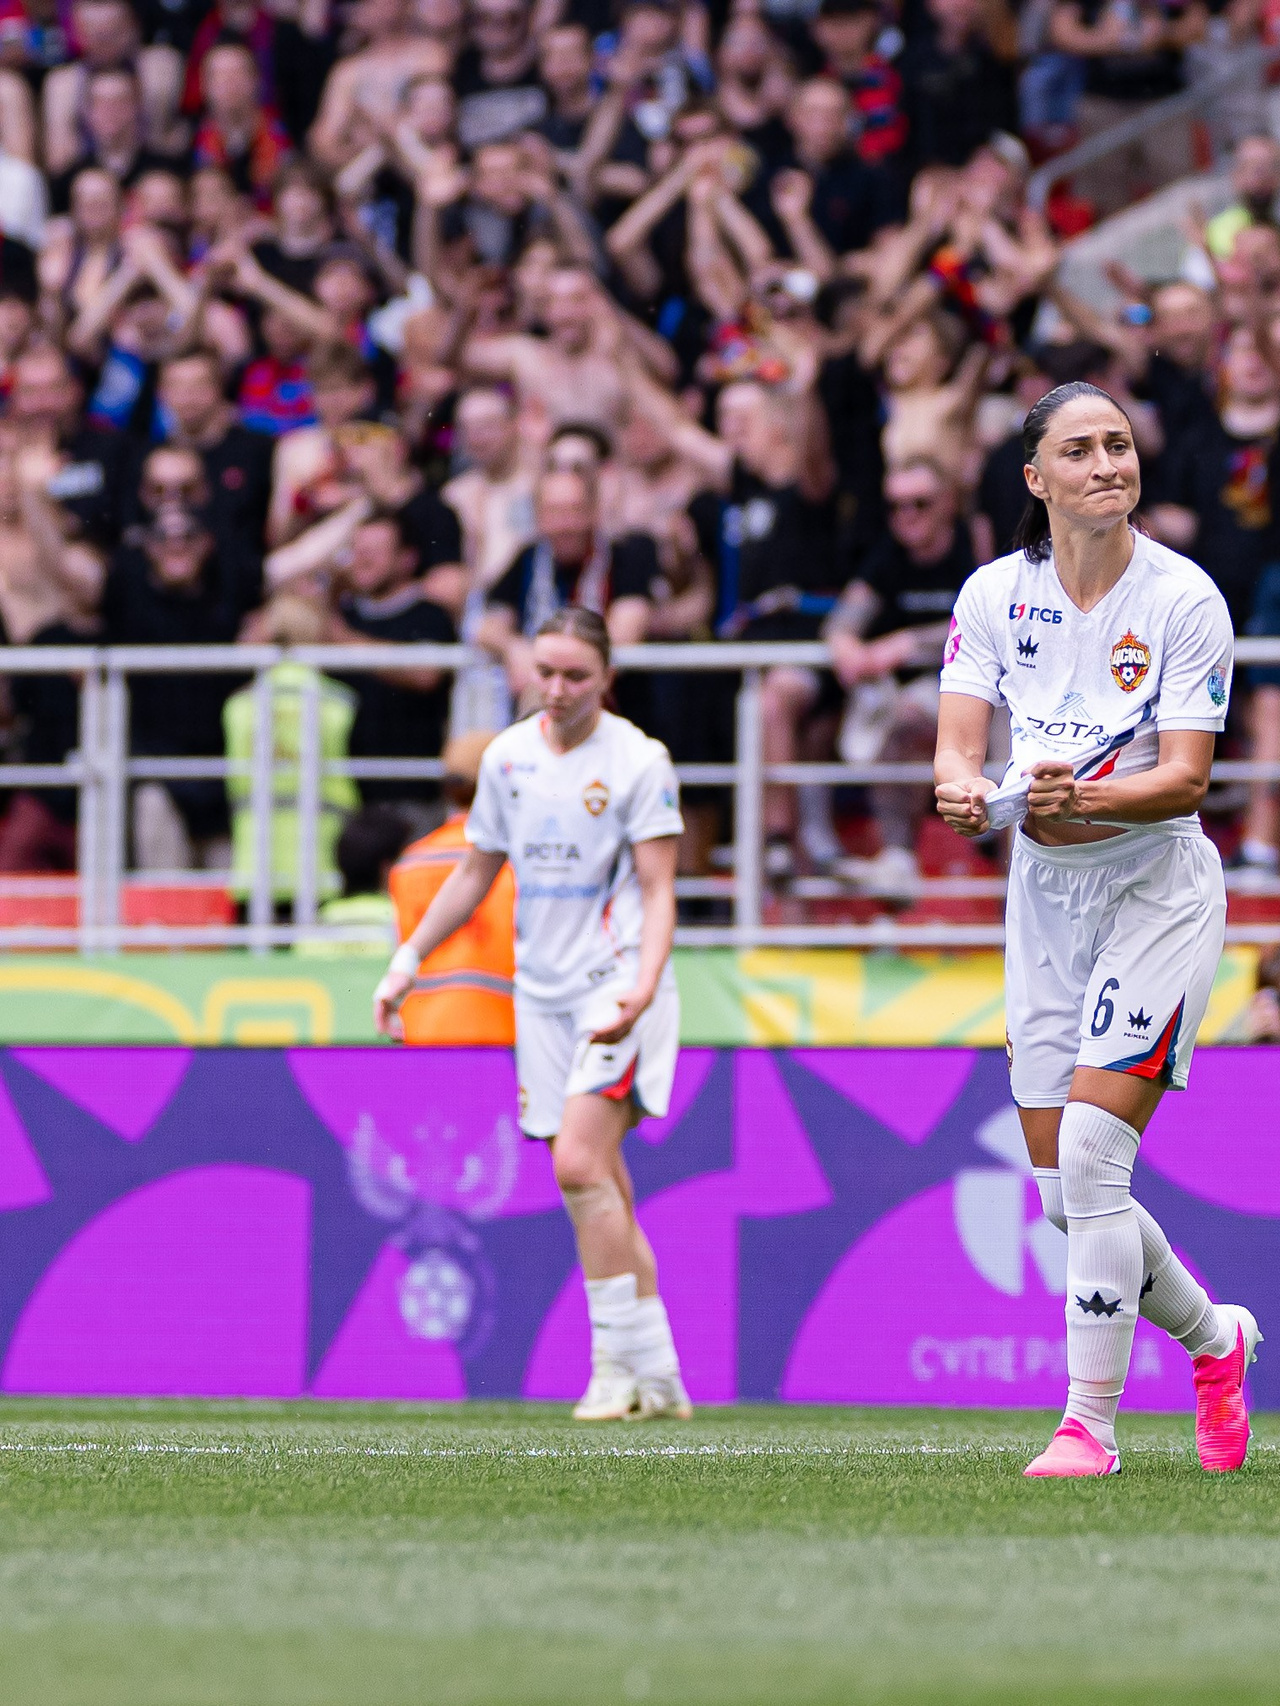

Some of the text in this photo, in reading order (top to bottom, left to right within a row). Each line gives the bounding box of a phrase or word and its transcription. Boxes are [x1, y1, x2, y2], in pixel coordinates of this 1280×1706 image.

[1029, 607, 1062, 624] ПСБ
[1111, 647, 1147, 667] ЦСКА
[1091, 977, 1120, 1037] 6
